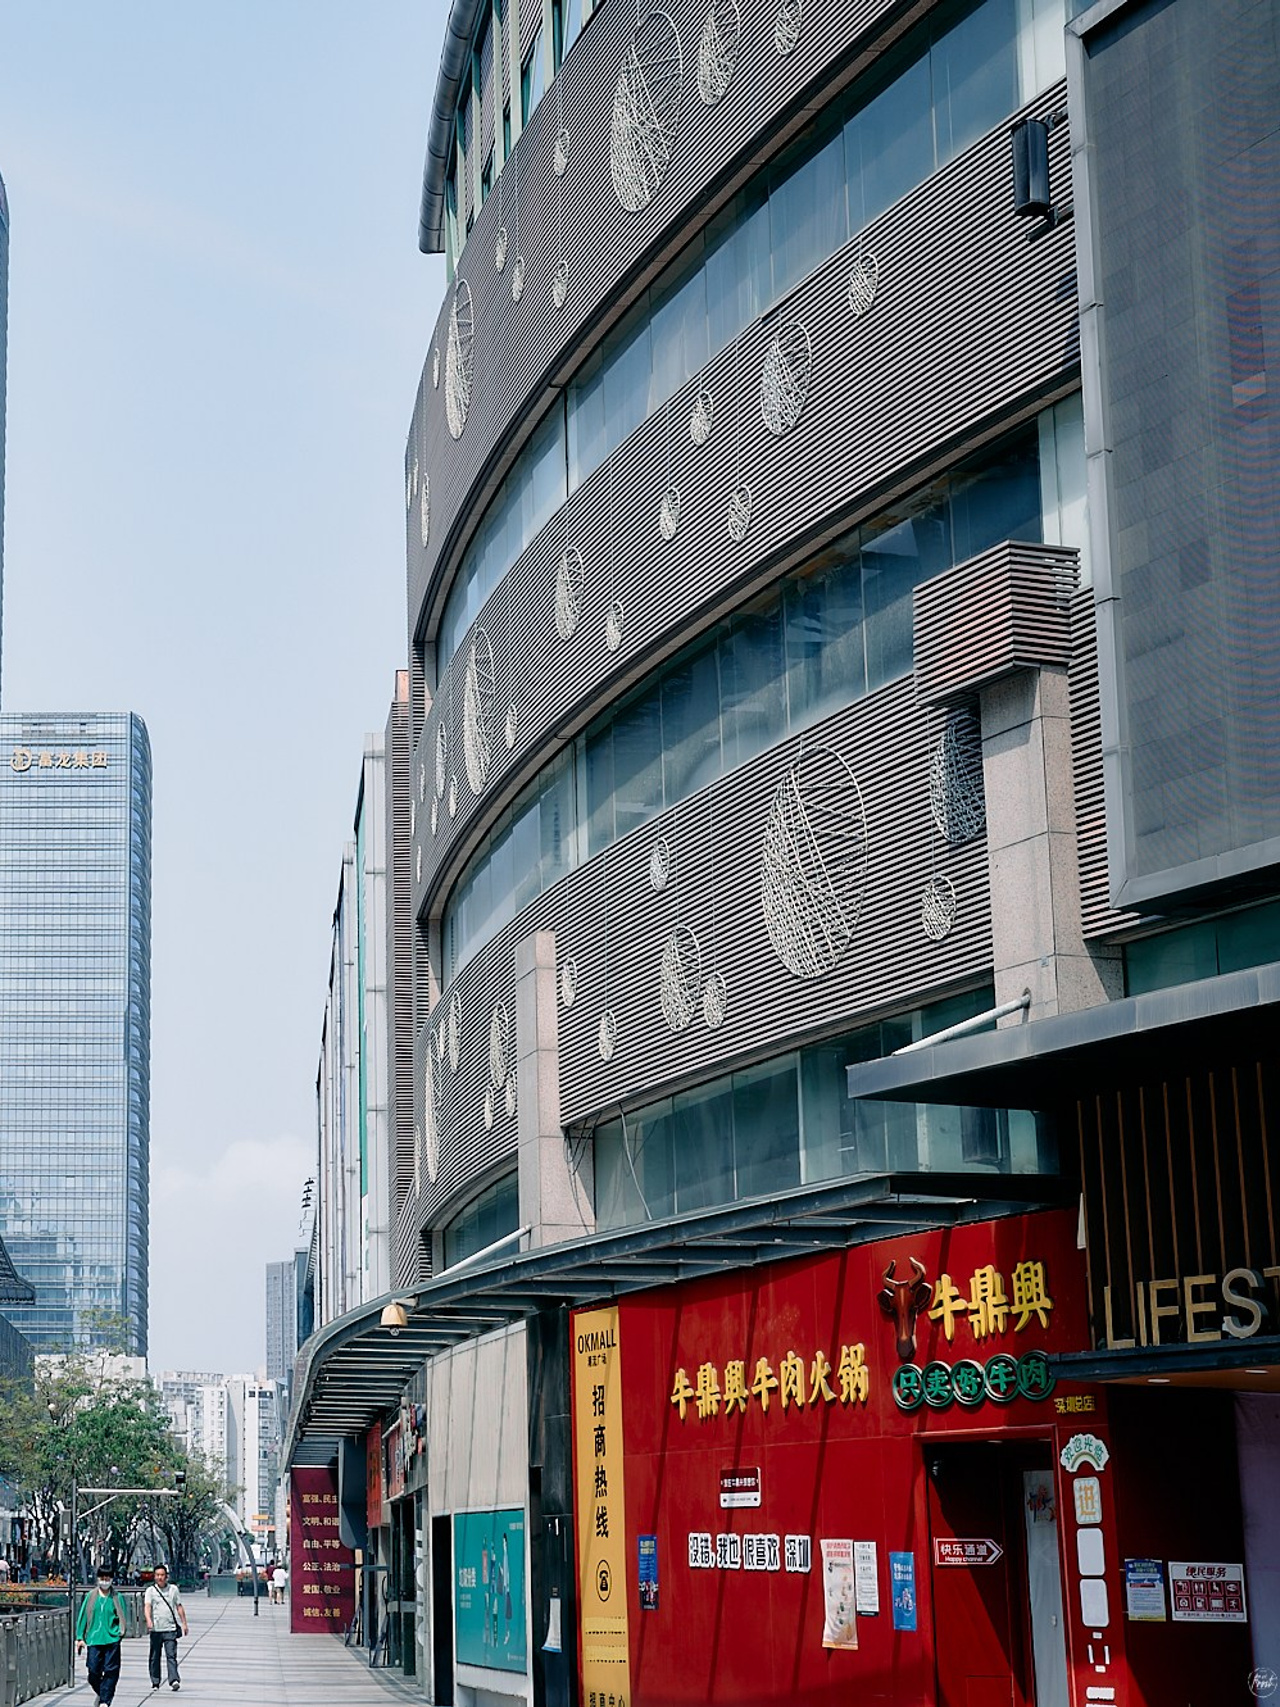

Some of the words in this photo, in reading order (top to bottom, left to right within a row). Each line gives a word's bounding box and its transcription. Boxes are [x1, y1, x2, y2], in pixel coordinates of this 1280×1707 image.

[577, 1329, 617, 1354] OKMALL
[898, 1357, 1050, 1399] 只卖好牛肉
[592, 1385, 609, 1539] 招商热线
[940, 1543, 988, 1556] 快乐通道
